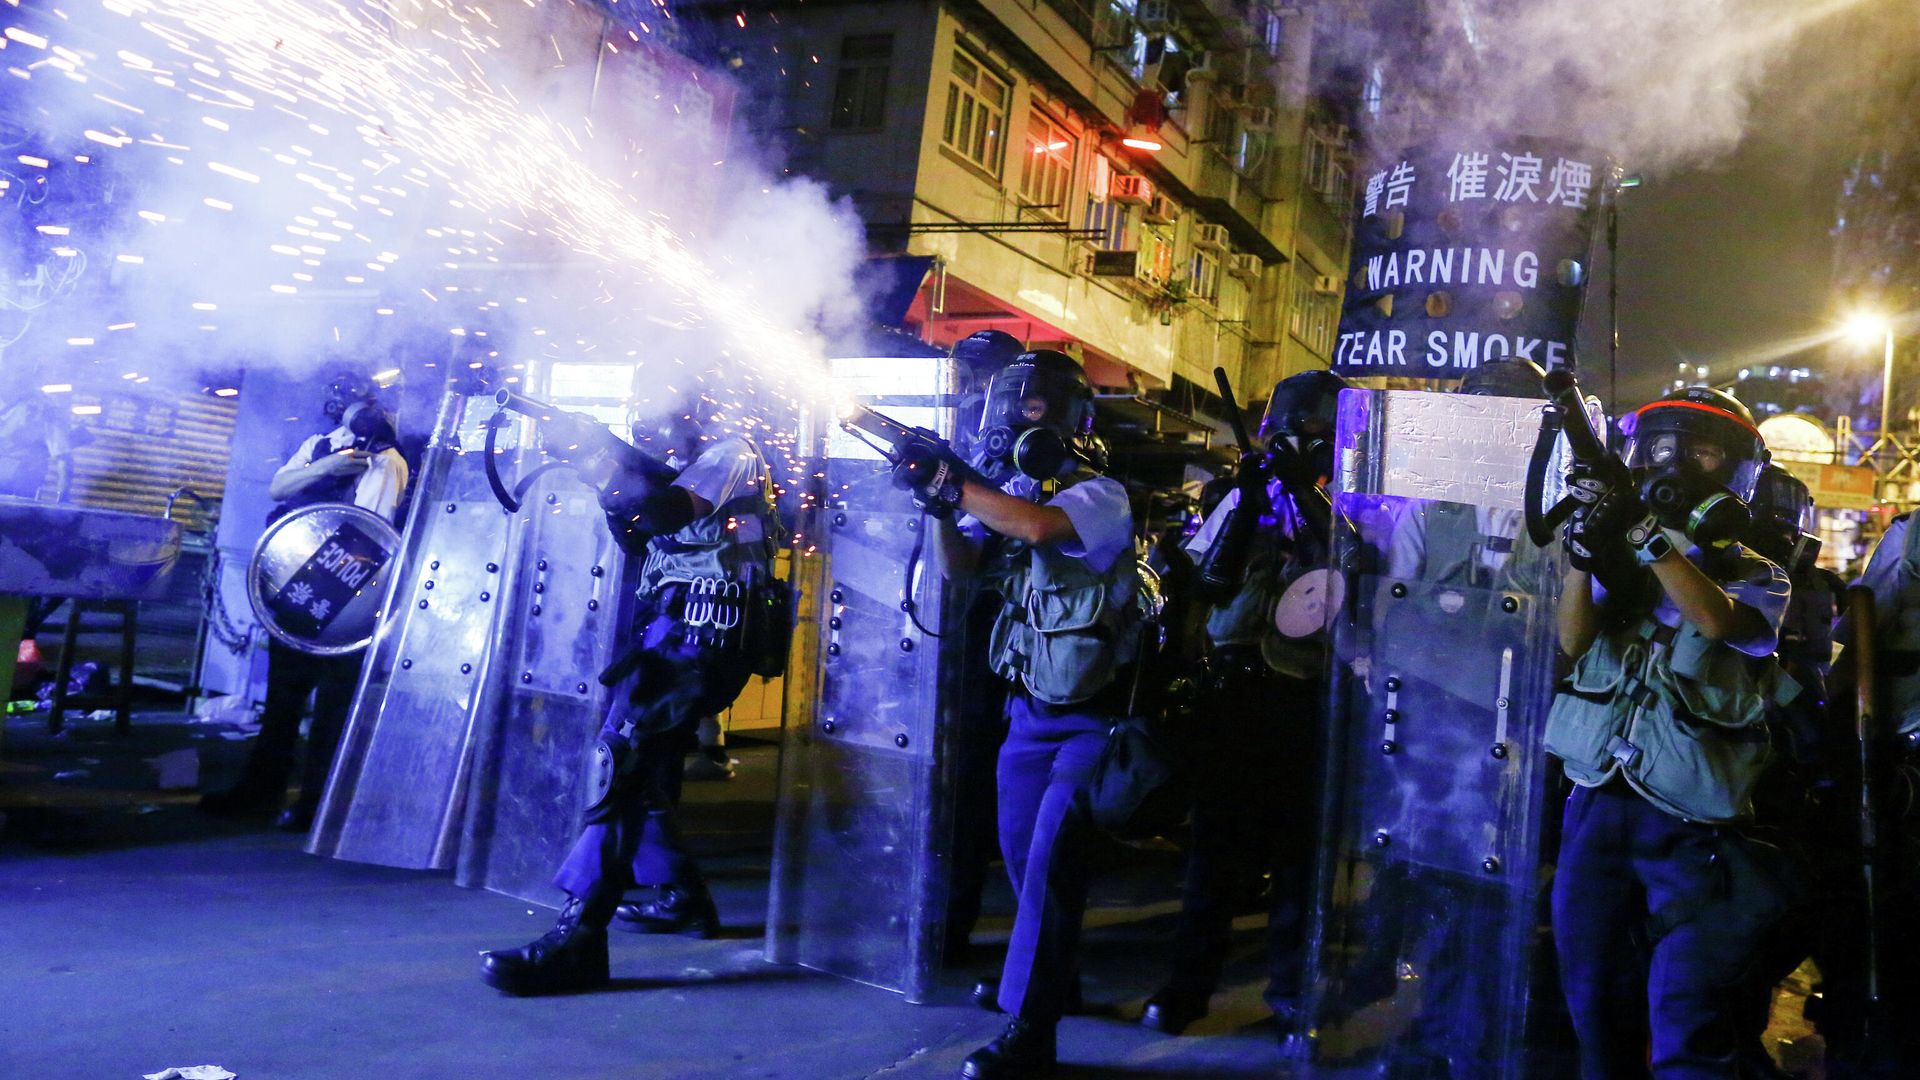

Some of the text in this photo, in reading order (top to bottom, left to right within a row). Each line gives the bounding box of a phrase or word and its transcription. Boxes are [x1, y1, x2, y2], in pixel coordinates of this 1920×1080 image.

[1363, 152, 1591, 218] 警告 催淚煙
[1367, 248, 1539, 291] WARNING
[1337, 330, 1407, 366] TEAR
[316, 542, 370, 588] POLICE
[288, 582, 331, 620] 警察
